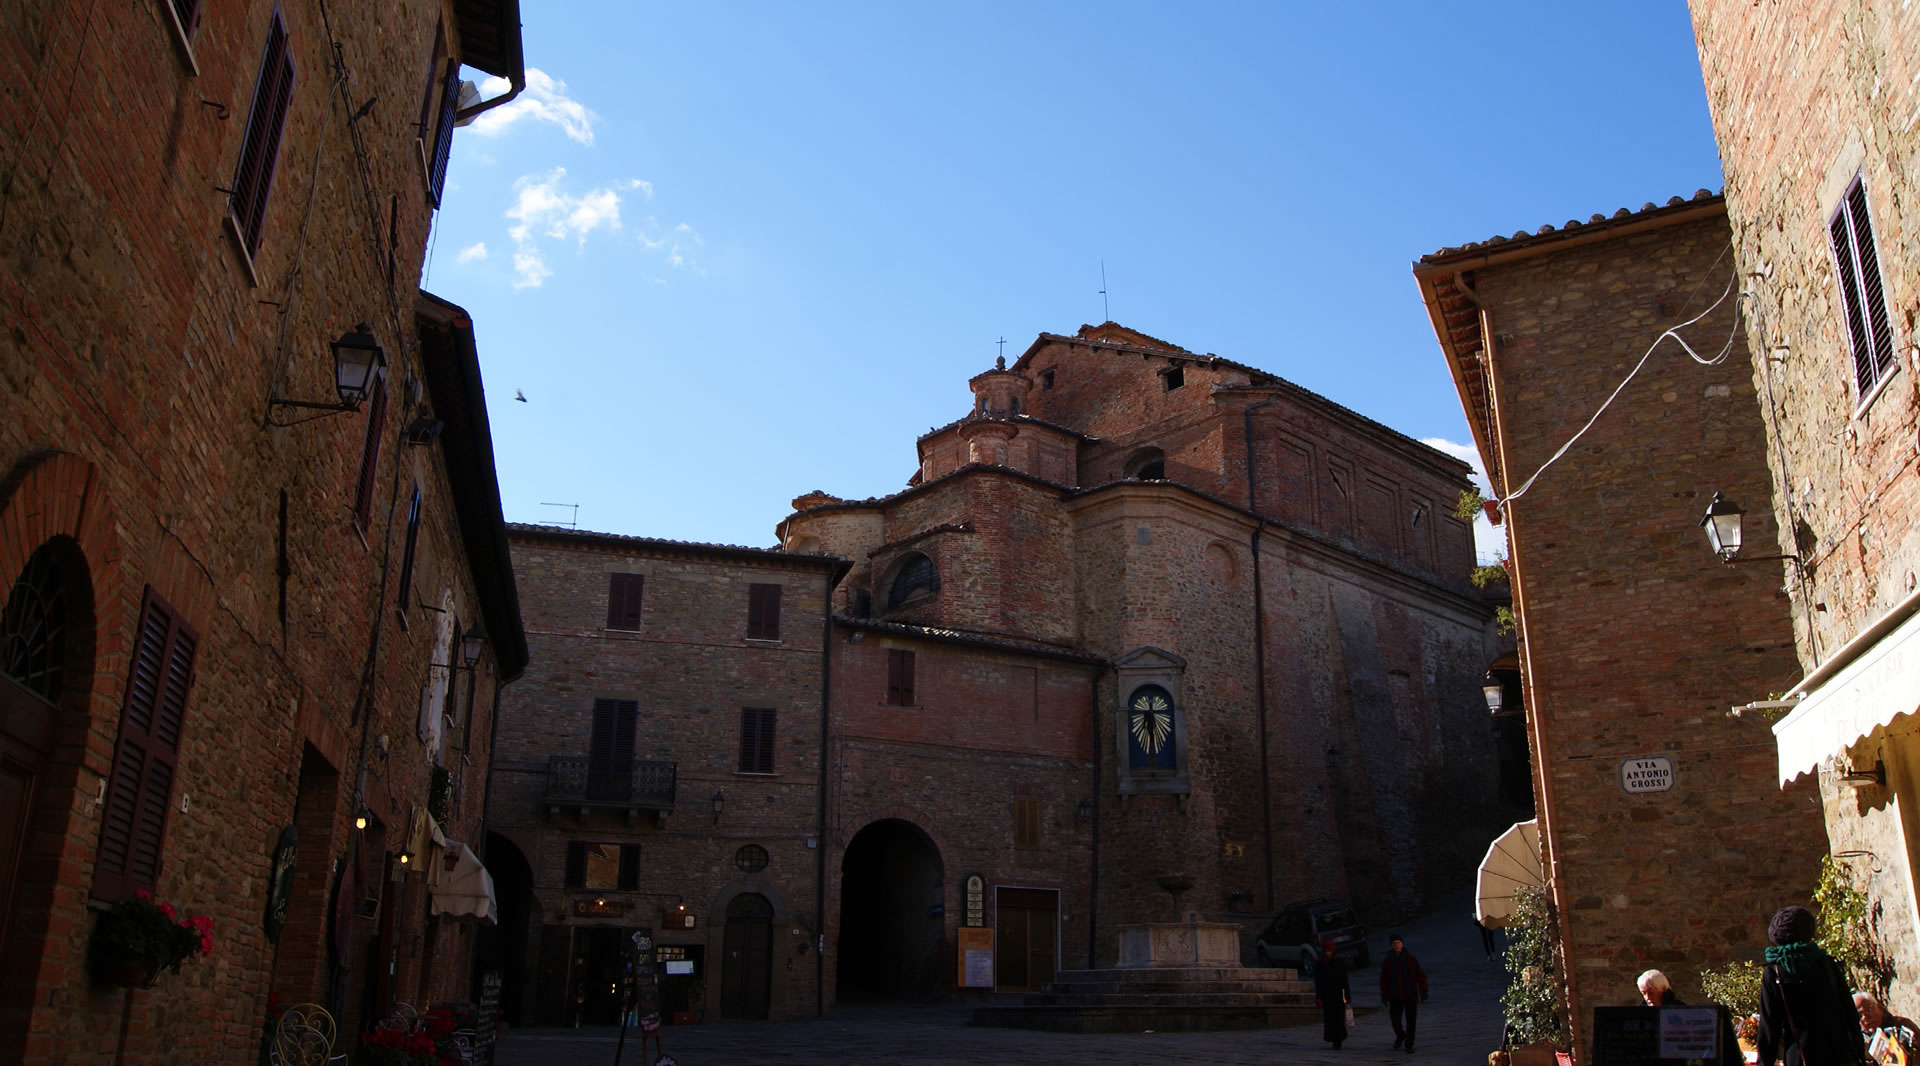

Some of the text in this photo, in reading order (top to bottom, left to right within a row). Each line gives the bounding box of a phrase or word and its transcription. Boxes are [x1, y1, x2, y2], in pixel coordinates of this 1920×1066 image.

[1636, 761, 1656, 769] VIA
[1626, 769, 1669, 780] ANTONIO
[1631, 779, 1666, 788] GROSSI
